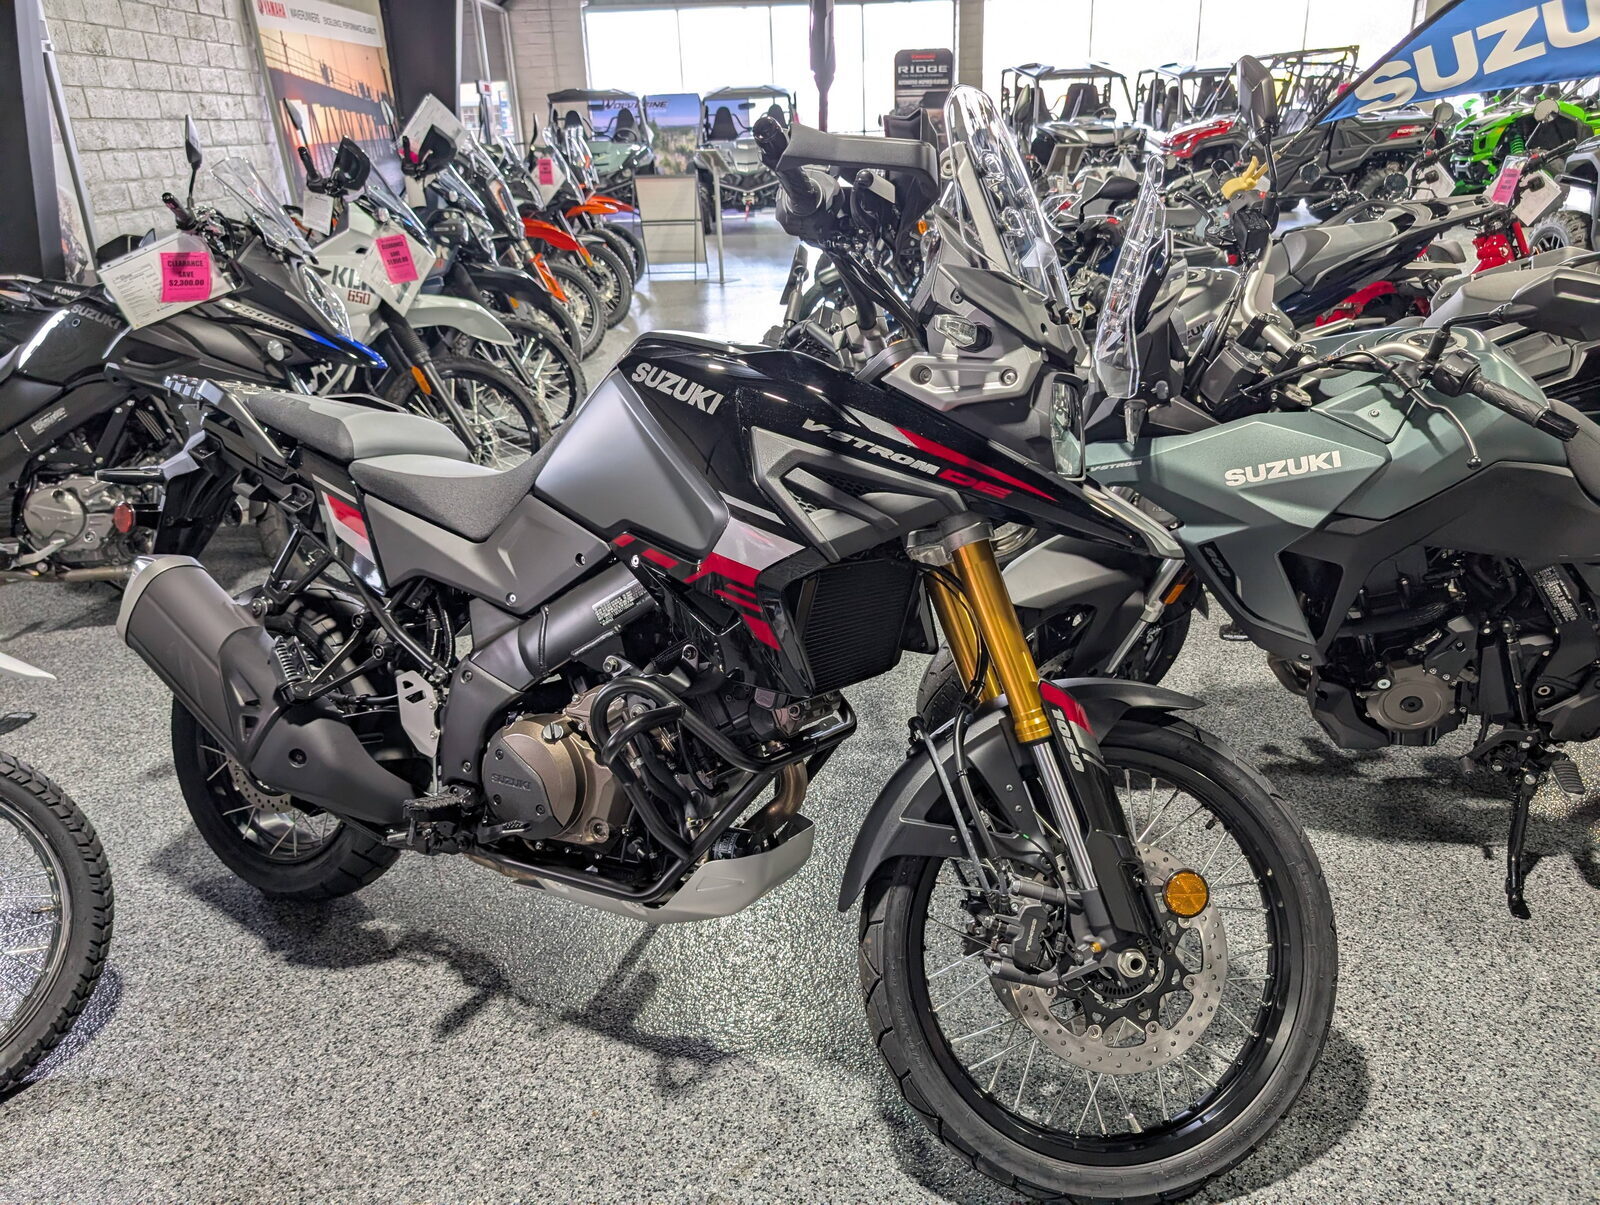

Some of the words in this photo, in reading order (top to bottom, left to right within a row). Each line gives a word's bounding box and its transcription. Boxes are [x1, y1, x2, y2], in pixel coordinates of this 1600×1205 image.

[1354, 0, 1600, 114] SUZU
[897, 65, 949, 74] RIDGE
[167, 260, 204, 268] CLEARANCE
[53, 285, 82, 298] Kawa
[168, 279, 205, 287] $2,300.00
[347, 289, 371, 306] 650
[70, 303, 122, 331] SUZUKI
[631, 362, 725, 416] SUZUKI
[802, 418, 941, 476] V-STROM
[937, 468, 1013, 500] DE
[1224, 450, 1342, 487] SUZUKI
[1051, 708, 1085, 773] 1050
[490, 772, 532, 792] SUZUKI
